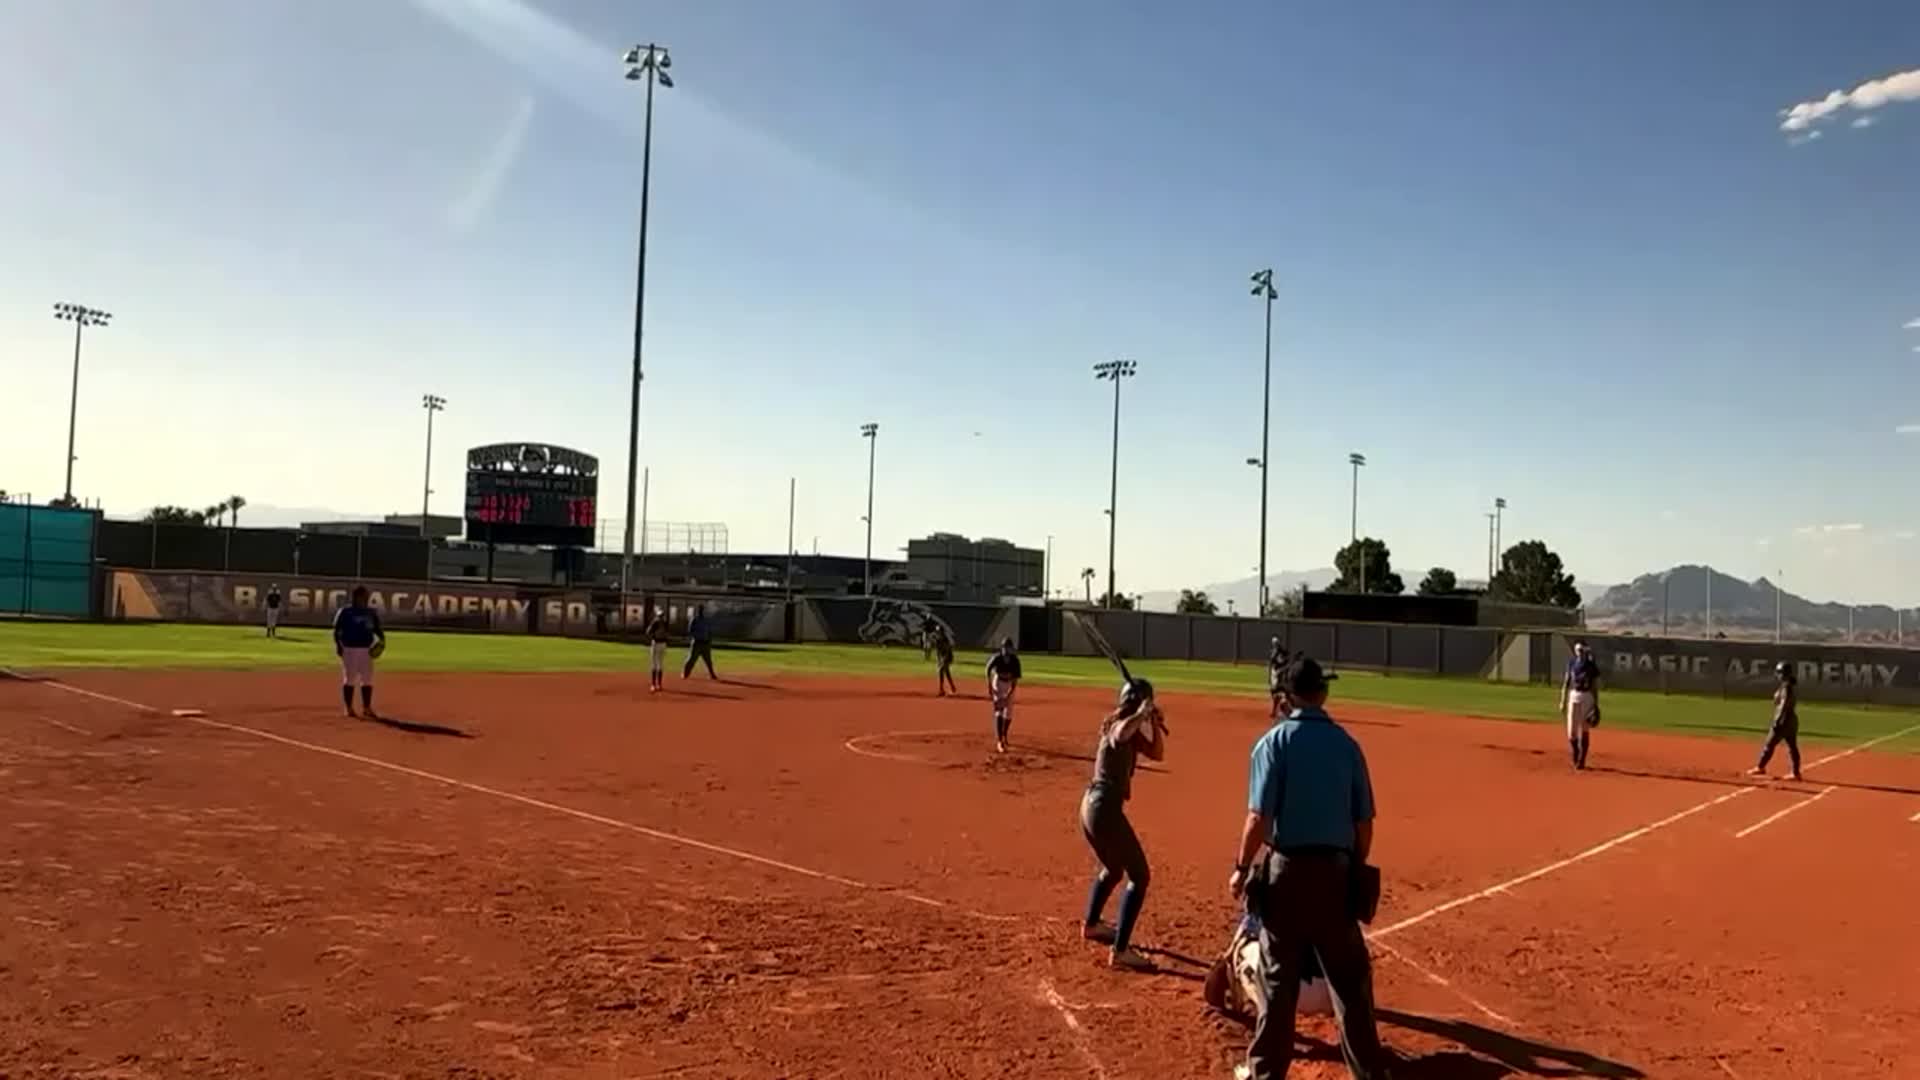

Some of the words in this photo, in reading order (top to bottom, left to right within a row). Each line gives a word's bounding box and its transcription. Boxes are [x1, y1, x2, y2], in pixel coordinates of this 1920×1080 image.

[234, 585, 348, 611] BSIC
[1614, 653, 1710, 675] BASIC
[1727, 657, 1900, 688] ACDEMY
